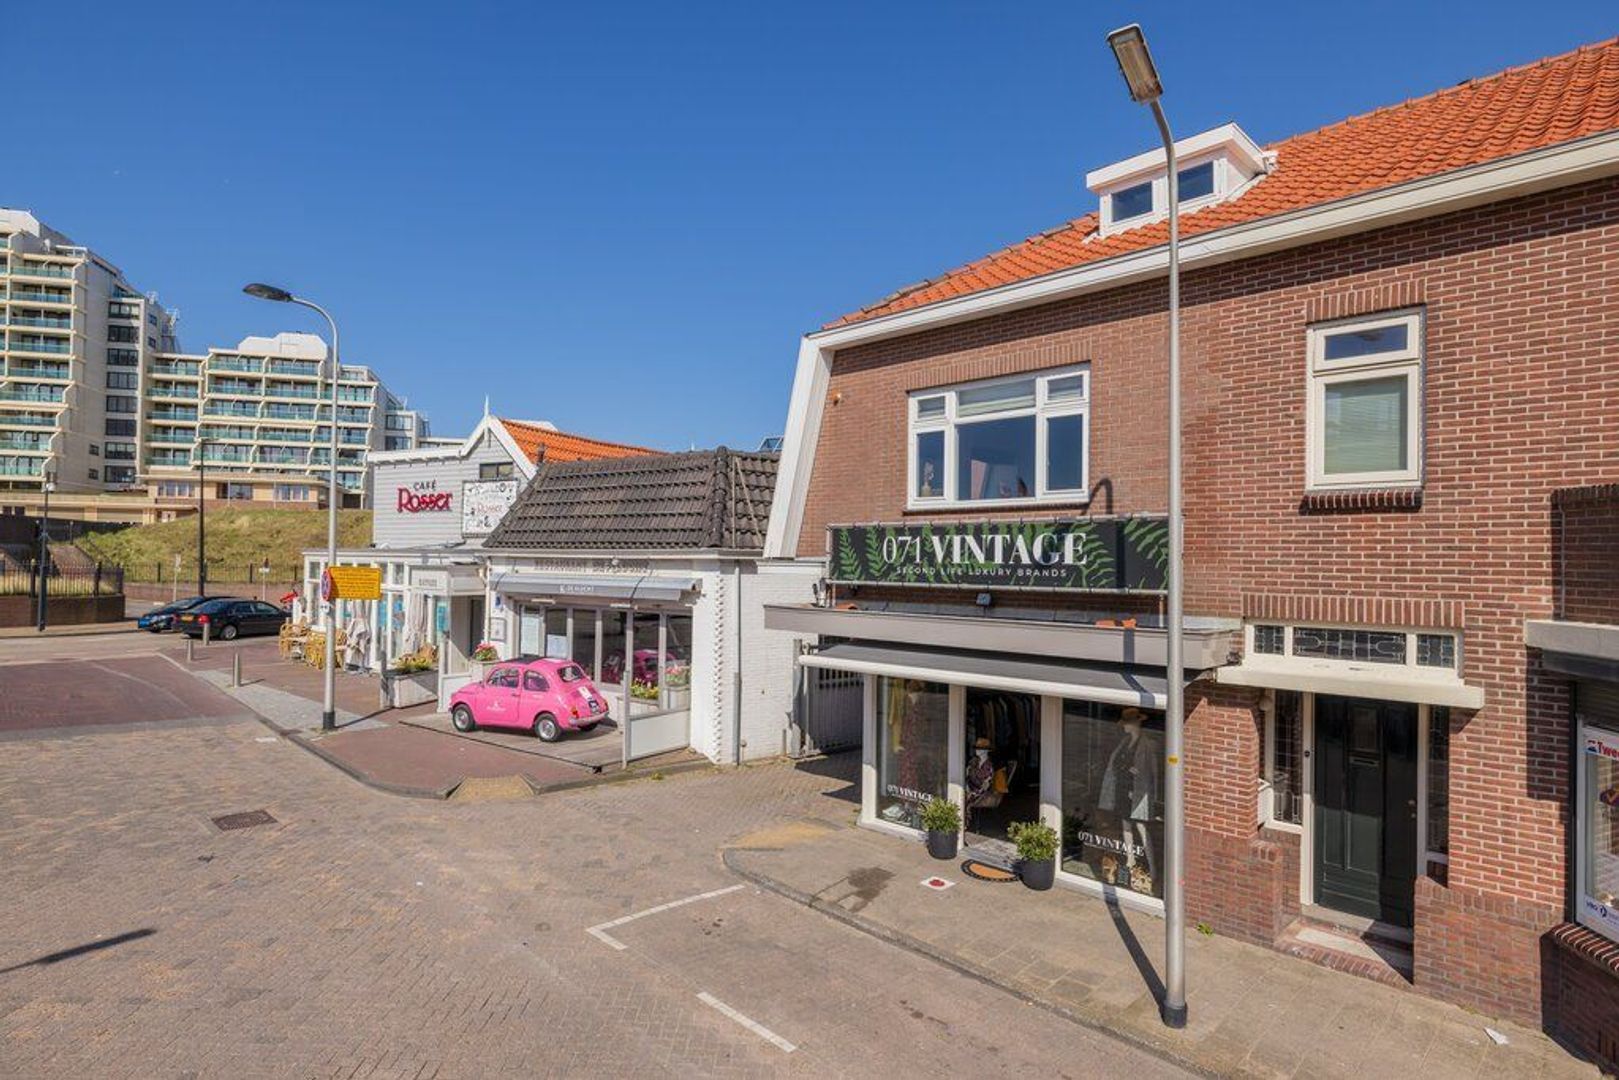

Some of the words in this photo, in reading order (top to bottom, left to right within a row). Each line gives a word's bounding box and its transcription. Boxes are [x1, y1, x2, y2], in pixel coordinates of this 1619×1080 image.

[413, 479, 437, 491] CAFÉ
[397, 486, 453, 514] Rosser
[882, 535, 922, 564] 071
[931, 532, 1088, 566] VINTAGE
[896, 566, 936, 576] SECOND
[940, 567, 963, 576] LIFE
[968, 568, 1012, 576] LUXURY
[1017, 568, 1068, 577] BRANDS
[899, 786, 934, 803] VINTAGE
[1078, 831, 1093, 843] 071
[1094, 834, 1145, 857] VINTAGE
